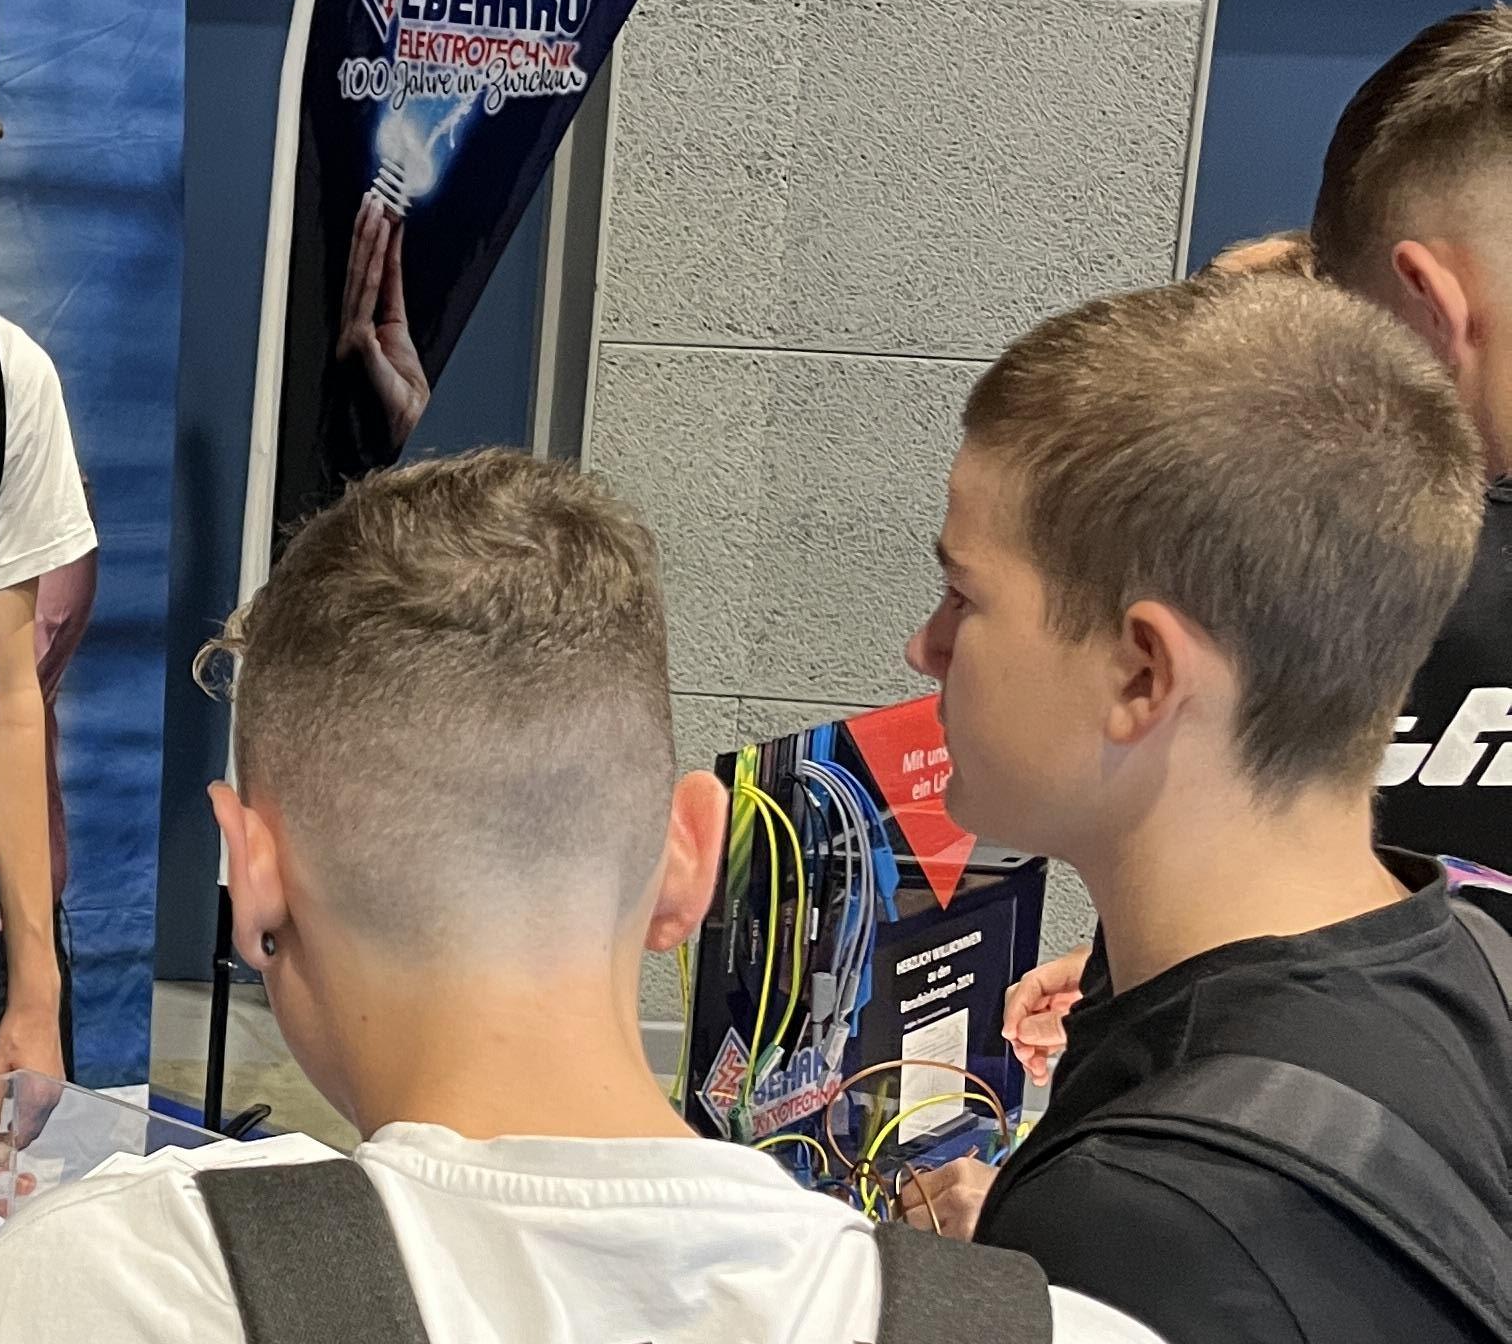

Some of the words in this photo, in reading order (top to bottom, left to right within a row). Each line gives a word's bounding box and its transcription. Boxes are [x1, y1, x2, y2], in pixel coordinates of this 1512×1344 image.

[398, 28, 578, 70] ELEKTROTECHNIK
[340, 60, 389, 97] 100
[393, 60, 453, 110] Jahre
[457, 64, 477, 93] in
[486, 57, 583, 111] Zwickau
[912, 777, 931, 800] ein
